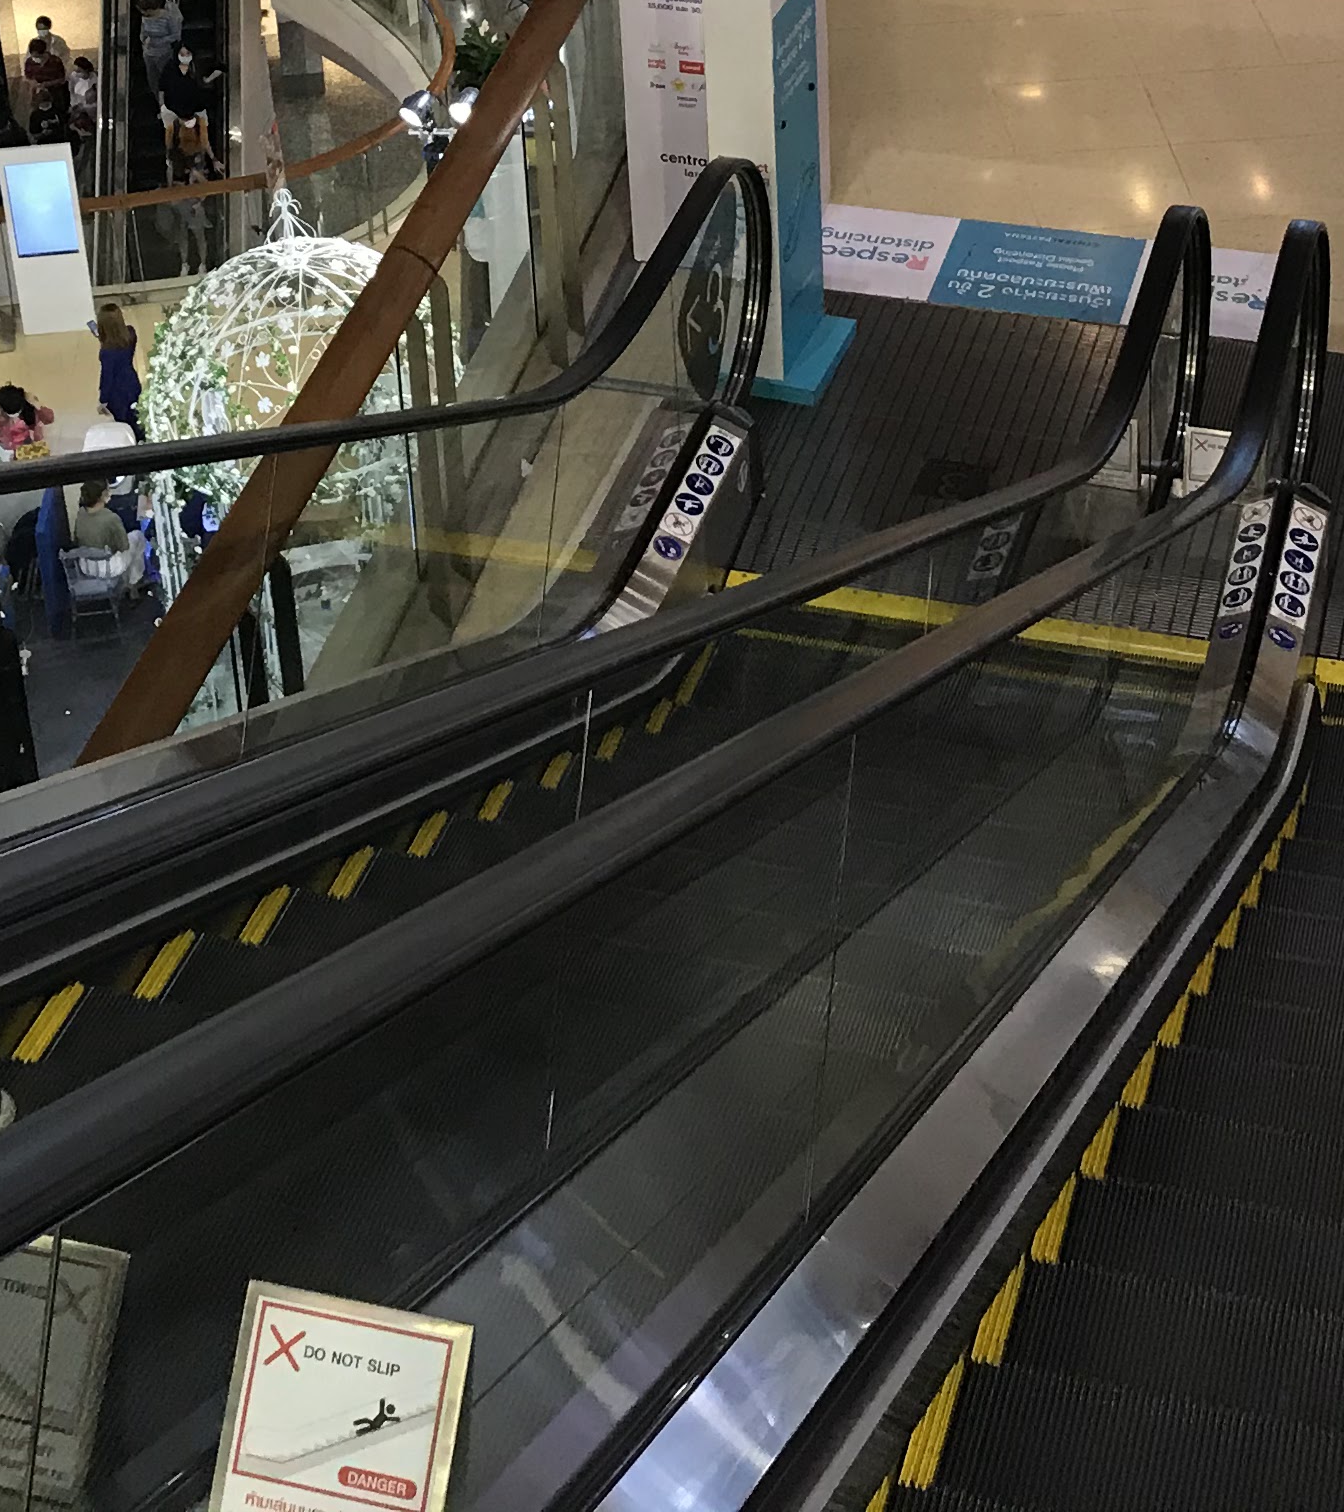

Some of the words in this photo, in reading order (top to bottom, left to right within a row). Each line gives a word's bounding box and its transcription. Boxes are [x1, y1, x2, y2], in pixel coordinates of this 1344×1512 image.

[660, 153, 708, 168] centra
[822, 226, 934, 251] distancing
[822, 243, 929, 271] Respec
[978, 283, 996, 299] 2
[303, 1345, 326, 1361] DO
[332, 1352, 363, 1369] NOT
[367, 1359, 401, 1377] SLIP
[347, 1470, 407, 1497] DANGER
